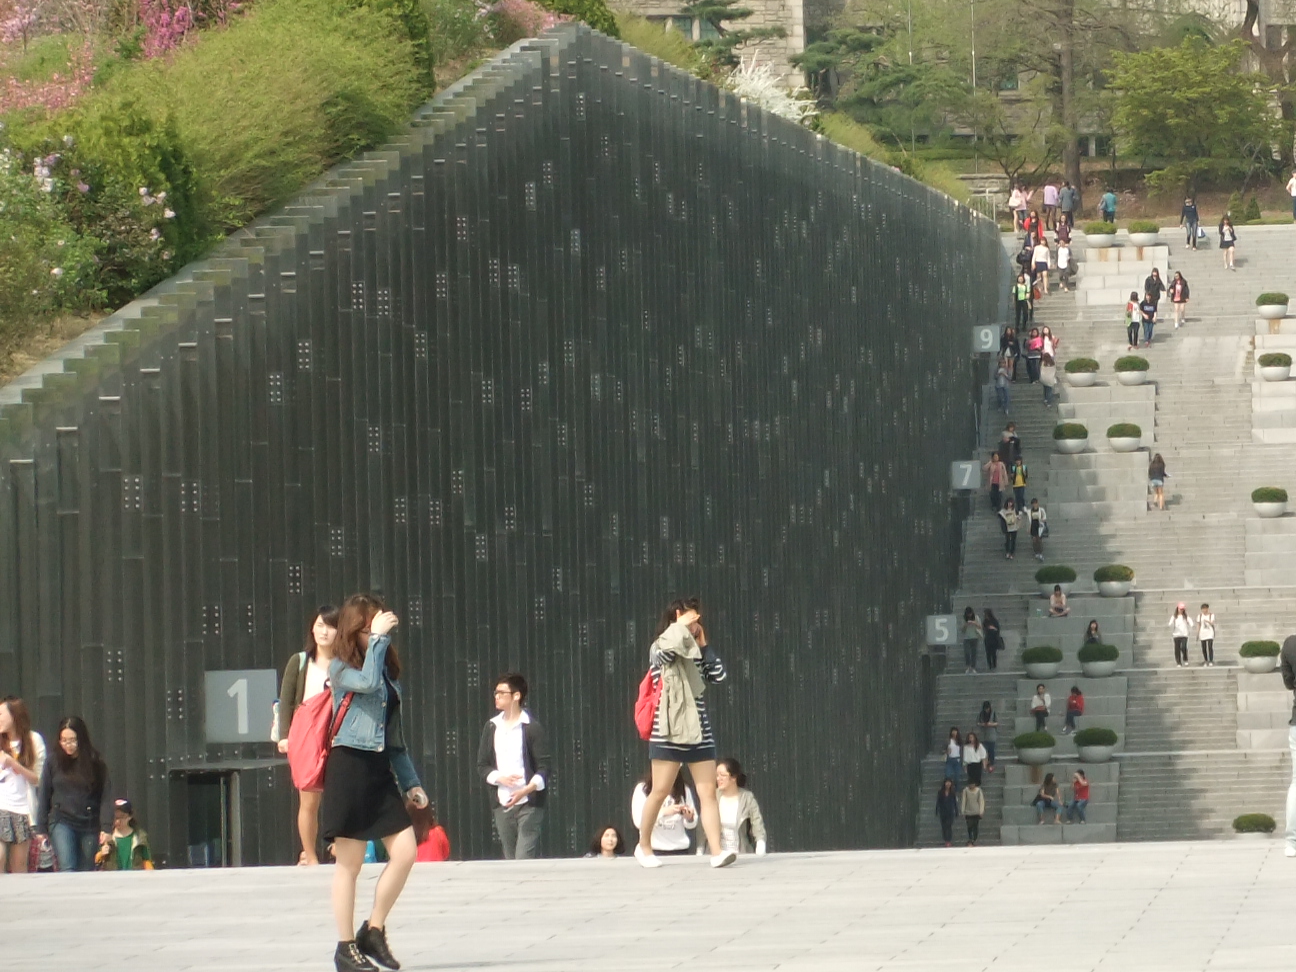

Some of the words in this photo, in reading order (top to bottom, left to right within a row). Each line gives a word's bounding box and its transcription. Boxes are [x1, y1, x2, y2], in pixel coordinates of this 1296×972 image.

[980, 329, 993, 349] 9
[960, 465, 972, 486] 7
[934, 618, 949, 642] 5
[226, 678, 249, 735] 1
